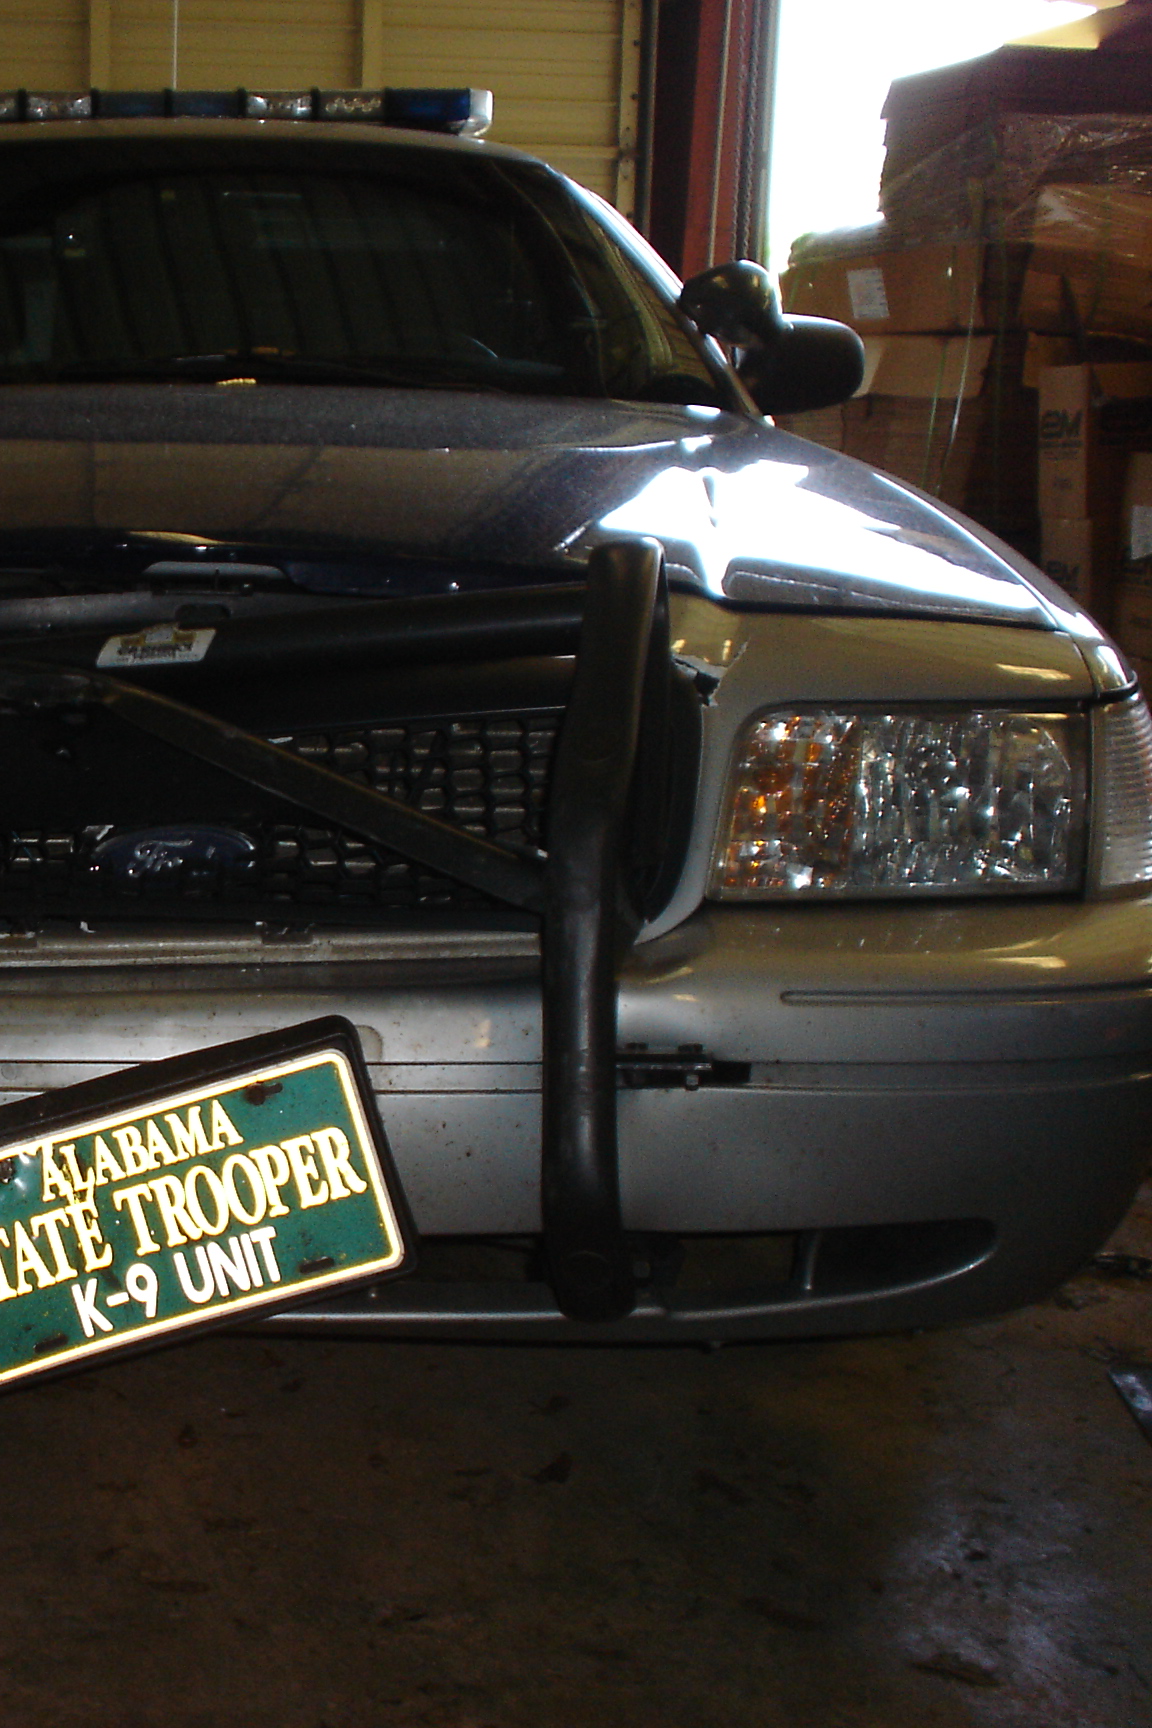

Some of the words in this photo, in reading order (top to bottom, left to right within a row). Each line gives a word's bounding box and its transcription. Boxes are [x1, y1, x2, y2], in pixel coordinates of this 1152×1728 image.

[41, 1099, 245, 1202] ALABAMA
[115, 1126, 368, 1257] TROOPER
[71, 1262, 160, 1338] K-9
[173, 1226, 282, 1304] UNIT
